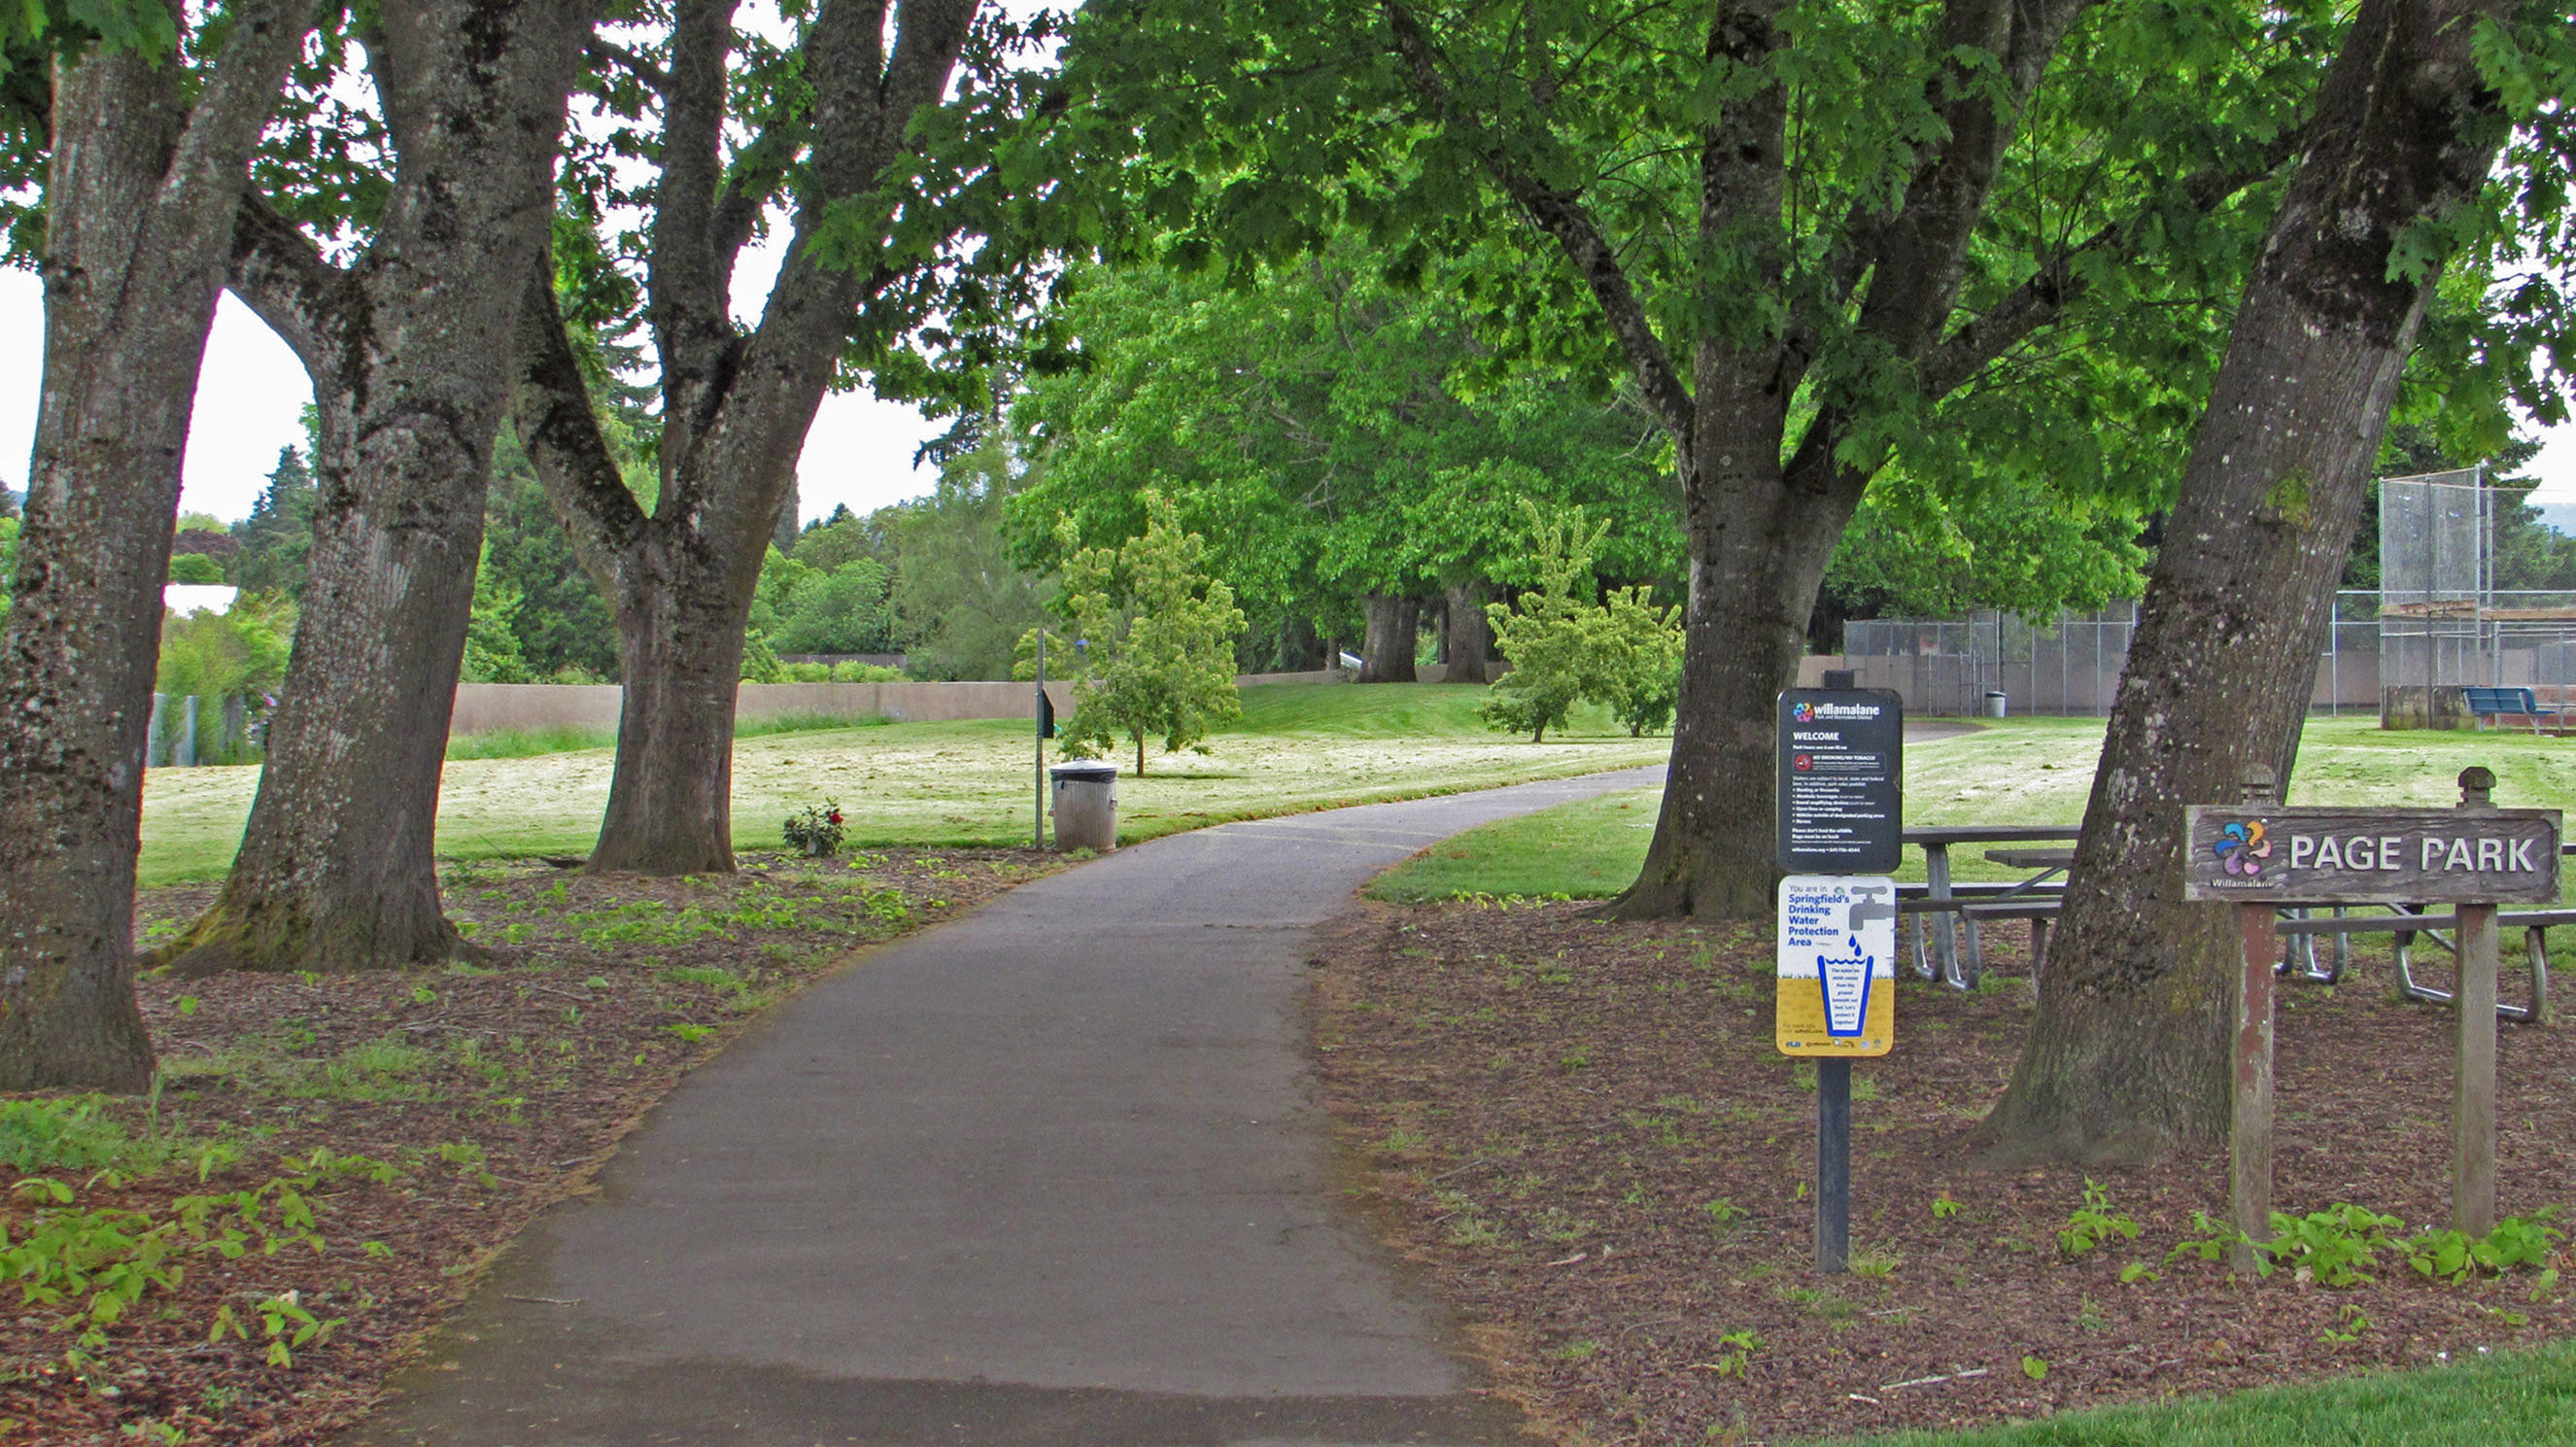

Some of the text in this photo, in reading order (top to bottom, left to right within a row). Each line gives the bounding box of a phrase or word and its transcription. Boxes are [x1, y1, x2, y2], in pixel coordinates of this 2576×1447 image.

[1814, 703, 1880, 715] willamalane
[1793, 732, 1839, 741] WELCOME
[2289, 835, 2536, 873] PAGE PARK
[1789, 894, 1849, 905] Springfield's
[1789, 905, 1831, 915] Drinking
[1788, 915, 1819, 924] Water
[1788, 926, 1838, 935] Protection
[1788, 937, 1812, 946] Area
